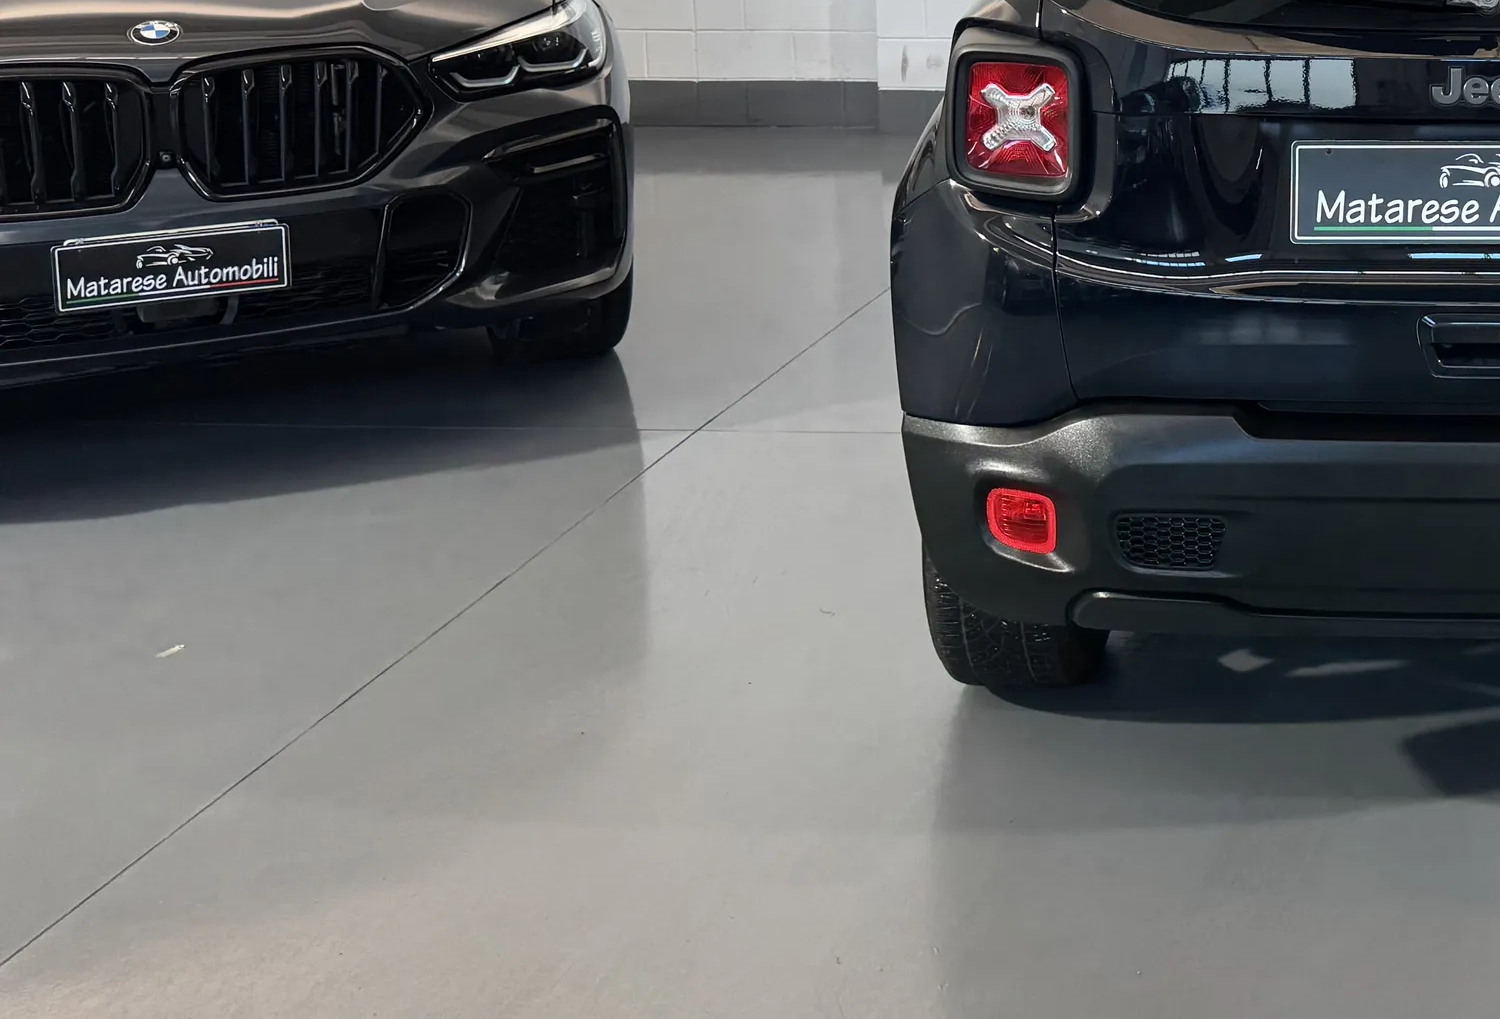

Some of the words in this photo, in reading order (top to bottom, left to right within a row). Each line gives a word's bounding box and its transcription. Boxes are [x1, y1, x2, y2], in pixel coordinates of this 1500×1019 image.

[1315, 188, 1480, 225] Matarese
[67, 273, 168, 299] Matarese
[173, 256, 279, 286] Automobili
